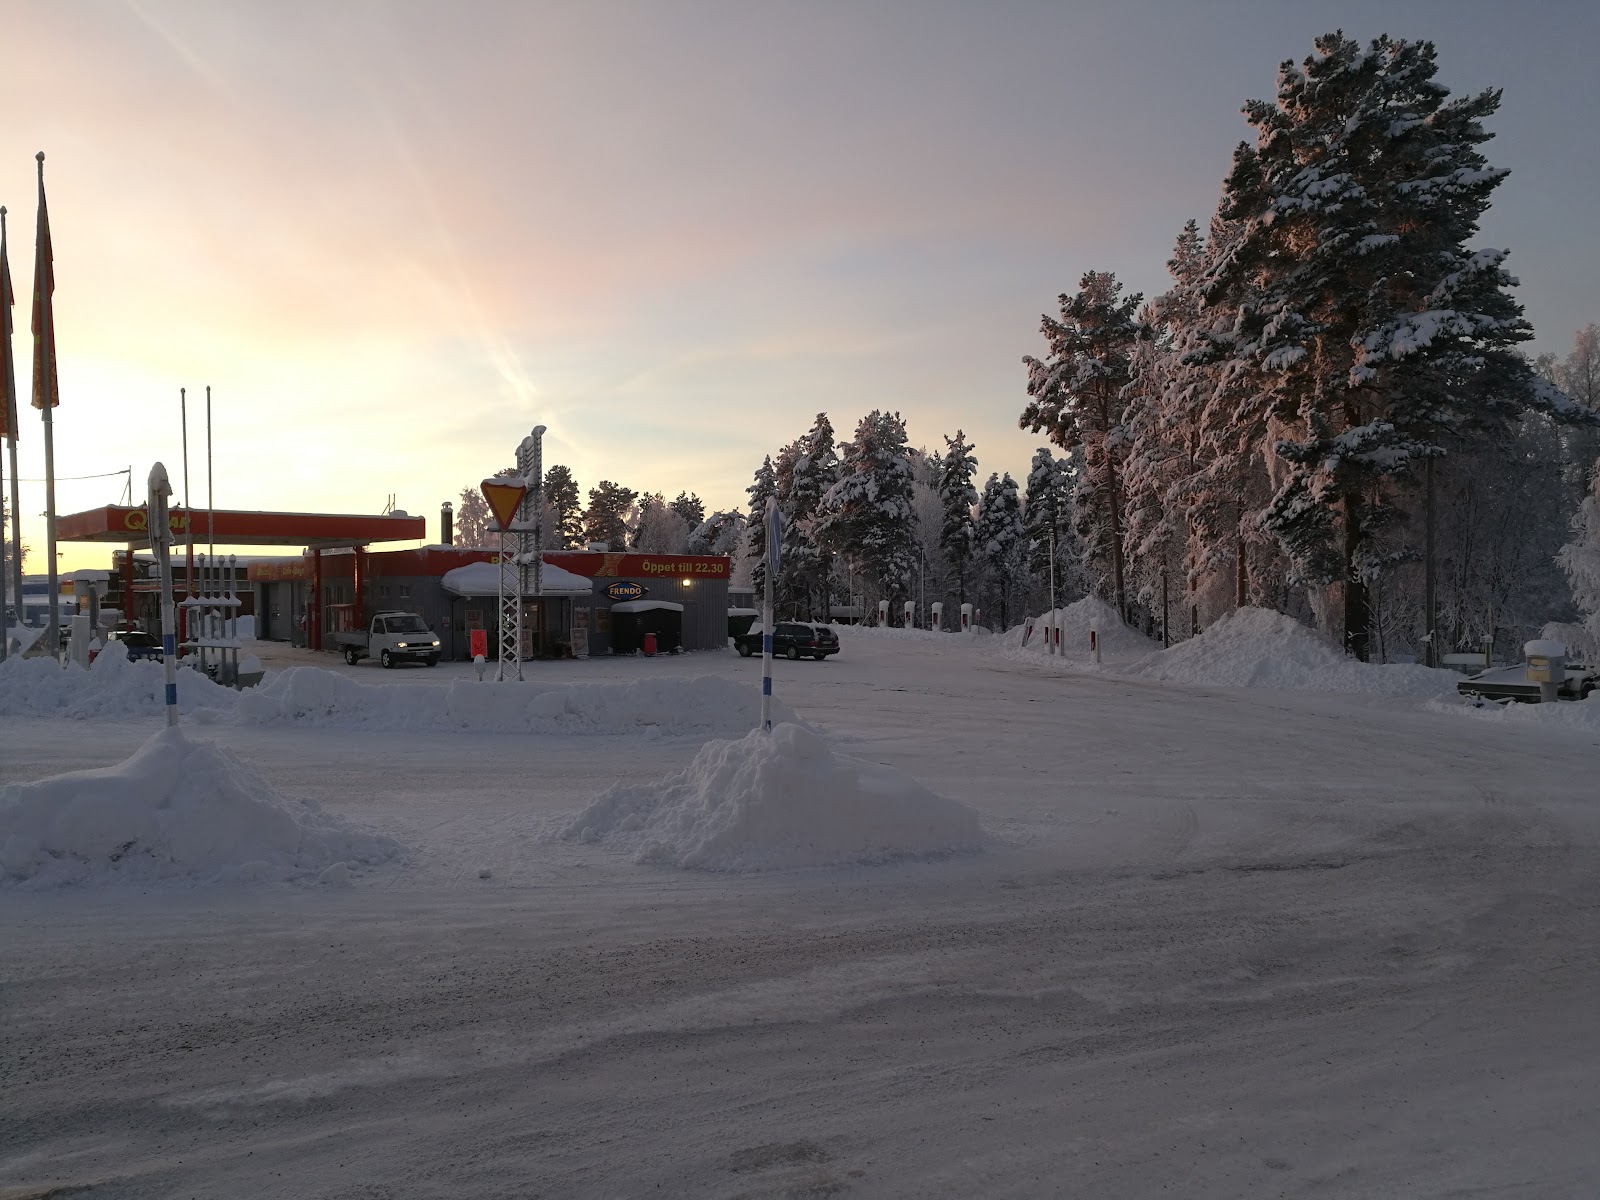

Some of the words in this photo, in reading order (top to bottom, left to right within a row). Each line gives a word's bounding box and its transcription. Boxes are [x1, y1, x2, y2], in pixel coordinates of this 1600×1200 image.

[642, 559, 676, 574] Öppet
[678, 563, 693, 573] till
[695, 563, 724, 574] 22.30
[609, 587, 642, 595] FRENDO
